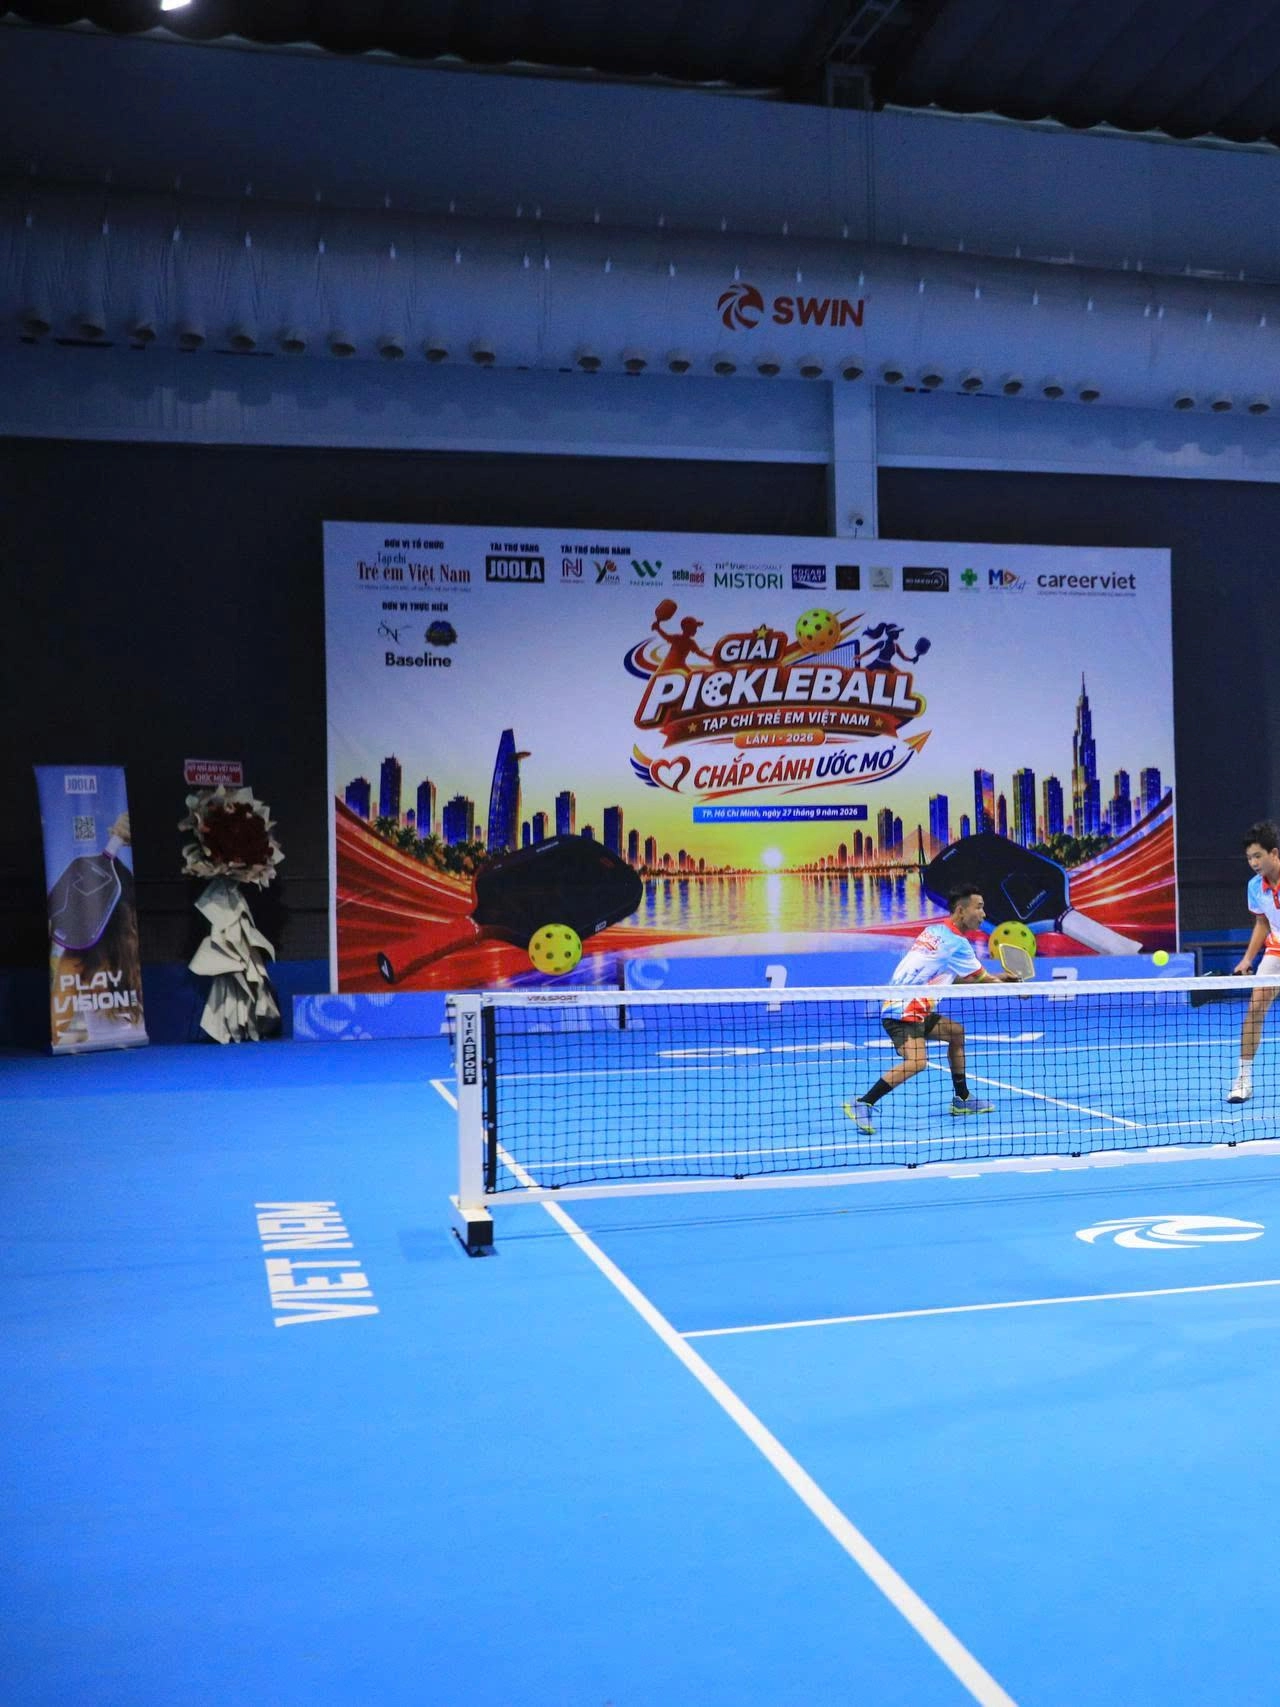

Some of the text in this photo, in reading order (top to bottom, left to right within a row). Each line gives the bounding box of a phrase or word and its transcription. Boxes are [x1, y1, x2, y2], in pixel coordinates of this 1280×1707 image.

[772, 296, 865, 328] SWIN
[383, 566, 404, 582] em
[408, 562, 436, 587] Việt
[439, 564, 471, 583] Nam
[488, 559, 543, 580] JOOLA
[714, 573, 784, 589] MISTORI
[385, 652, 452, 669] Baseline
[640, 667, 920, 722] PICKLEBALL
[703, 714, 728, 733] TẠP
[731, 711, 754, 728] CHÍ
[784, 711, 805, 724] EM
[808, 709, 837, 727] VIỆT
[839, 713, 870, 726] NAM
[786, 734, 814, 743] 2026
[694, 745, 897, 789] CHẮP CÁNH ƯỚC MƠ
[67, 778, 96, 791] JOOLA
[702, 809, 714, 817] TP.
[726, 807, 740, 817] Chí
[741, 808, 761, 818] Minh,
[762, 809, 782, 819] ngày
[782, 808, 792, 817] 27
[793, 807, 816, 819] tháng
[840, 807, 858, 817] 2026
[60, 970, 123, 992] PLAY
[54, 990, 138, 1015] VISION!
[463, 1013, 476, 1085] VIFASPORT
[254, 1201, 380, 1328] VIET NAM
